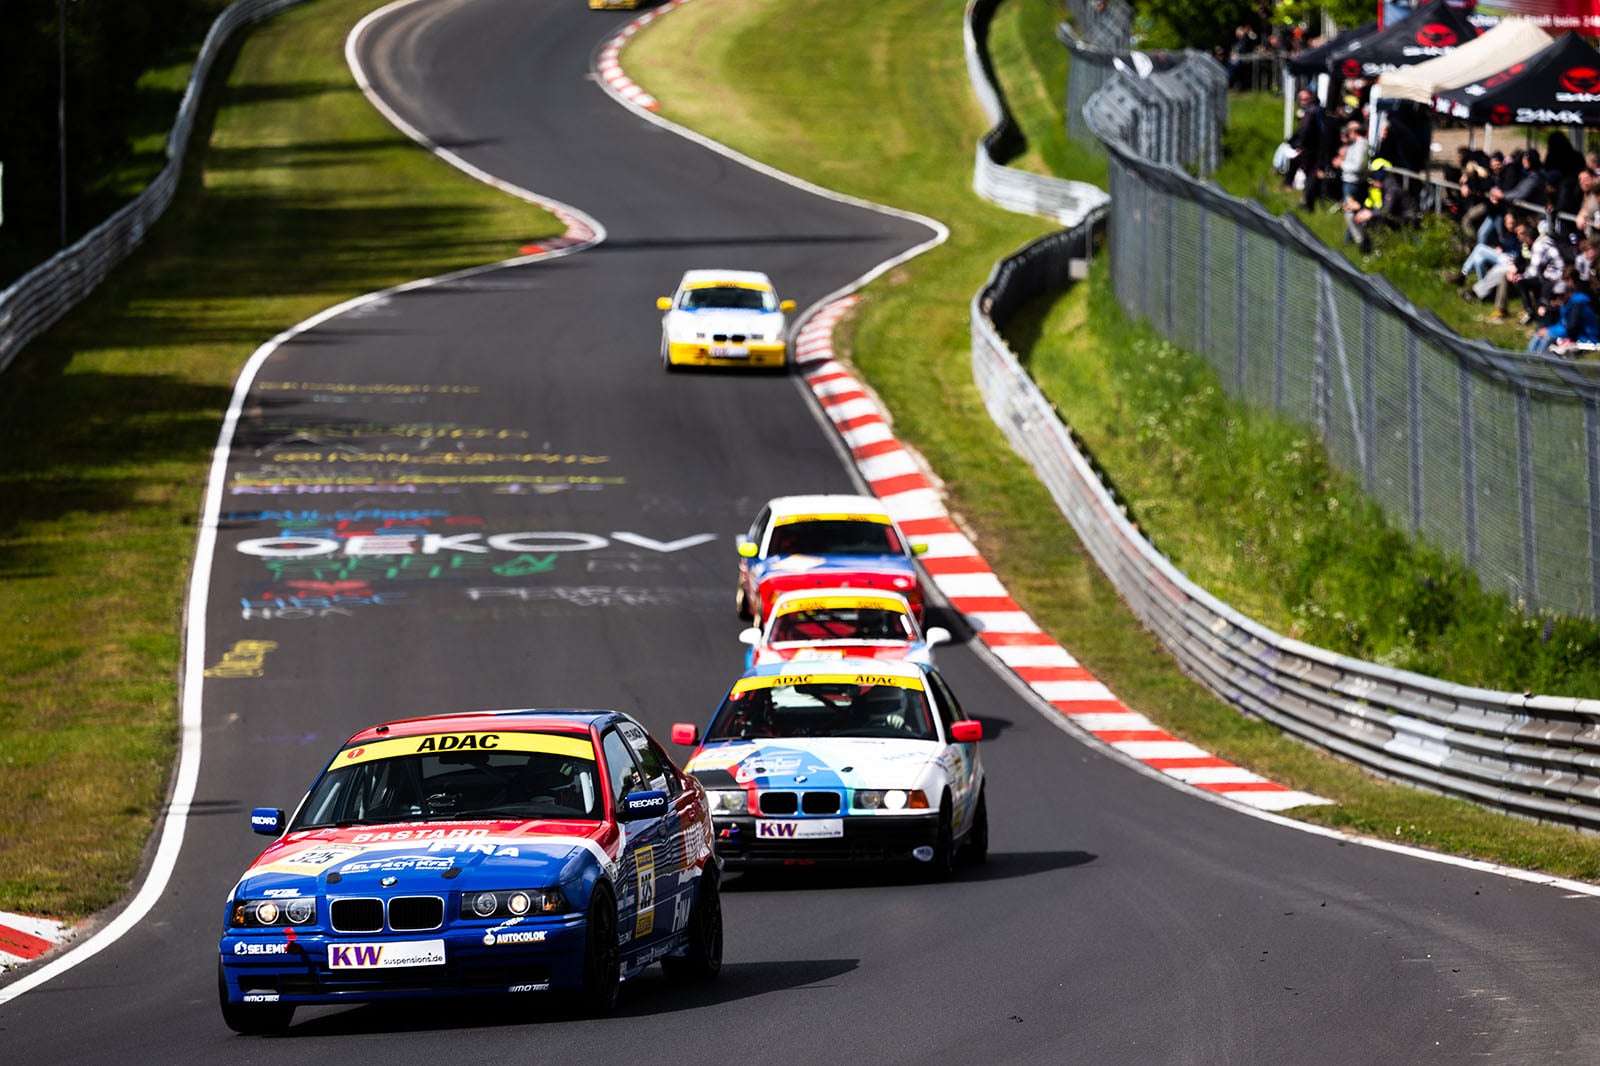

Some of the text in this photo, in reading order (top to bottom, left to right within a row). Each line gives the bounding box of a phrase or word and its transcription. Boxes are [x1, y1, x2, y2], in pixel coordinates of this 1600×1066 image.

[773, 674, 897, 686] ADAC ADAC
[417, 734, 500, 752] ADAC
[629, 797, 665, 808] RECARO
[251, 816, 277, 825] RECARO
[352, 828, 490, 843] BASTARD
[760, 823, 798, 837] KW
[428, 840, 520, 857] FINA
[497, 931, 546, 943] AUTOCOLOR
[332, 945, 443, 967] KW suspensions.de
